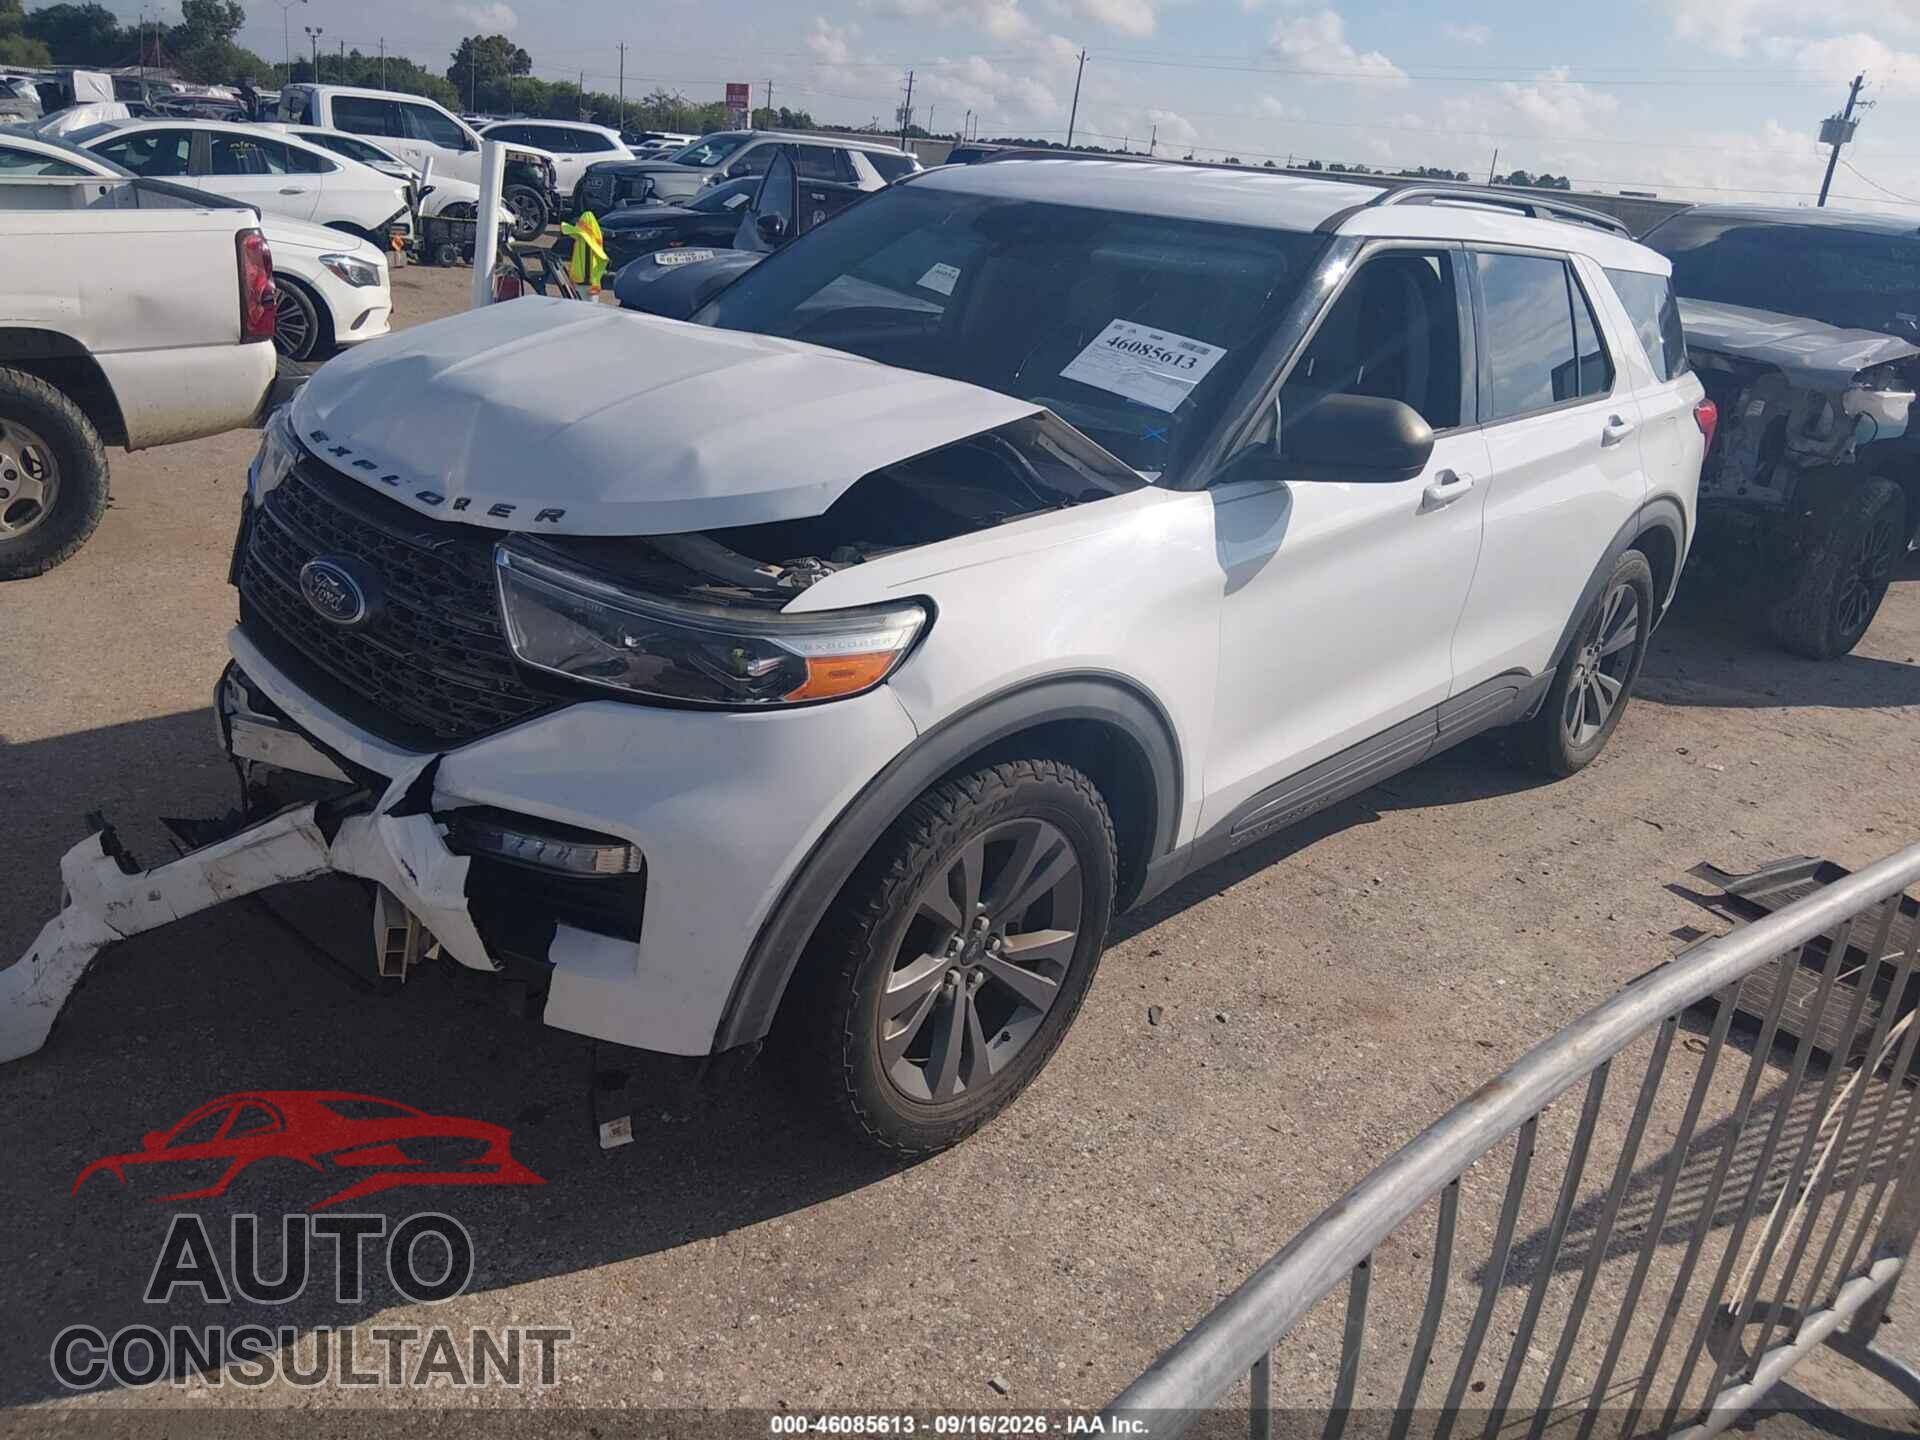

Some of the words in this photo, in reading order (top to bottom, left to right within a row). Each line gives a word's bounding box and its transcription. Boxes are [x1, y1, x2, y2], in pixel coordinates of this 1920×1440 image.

[1106, 335, 1198, 370] 46085613
[309, 430, 566, 523] EXPLORER
[311, 572, 347, 611] Ford
